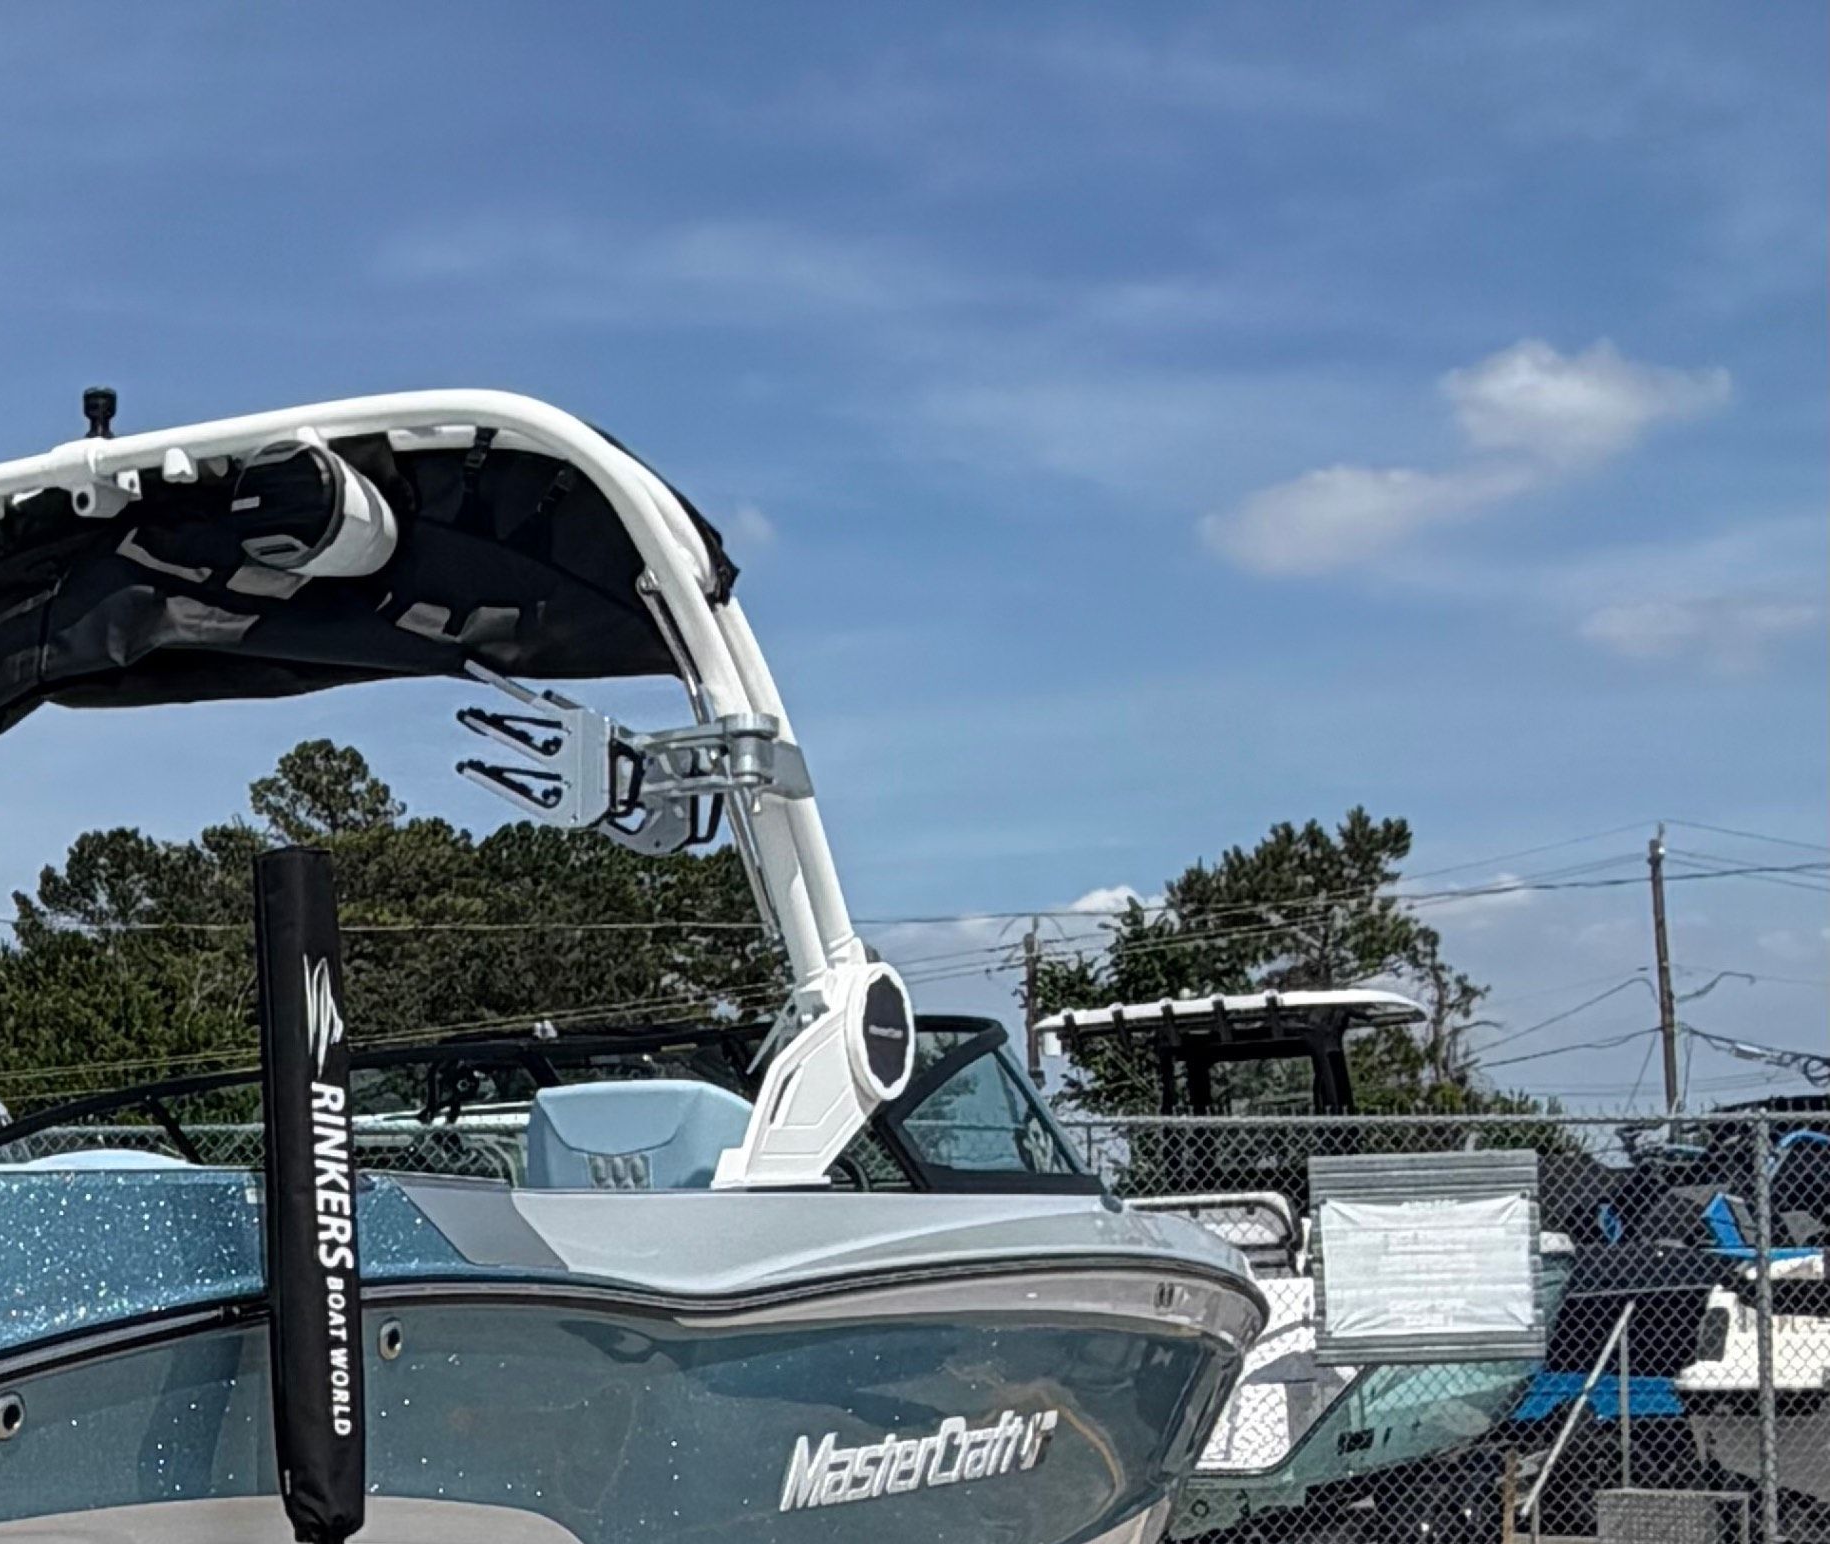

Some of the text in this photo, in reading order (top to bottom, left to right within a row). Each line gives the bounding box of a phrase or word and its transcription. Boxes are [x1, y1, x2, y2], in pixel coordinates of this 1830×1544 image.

[310, 1081, 355, 1436] RINKERS BOAT WORLD
[779, 1410, 1024, 1512] MasterCraft
